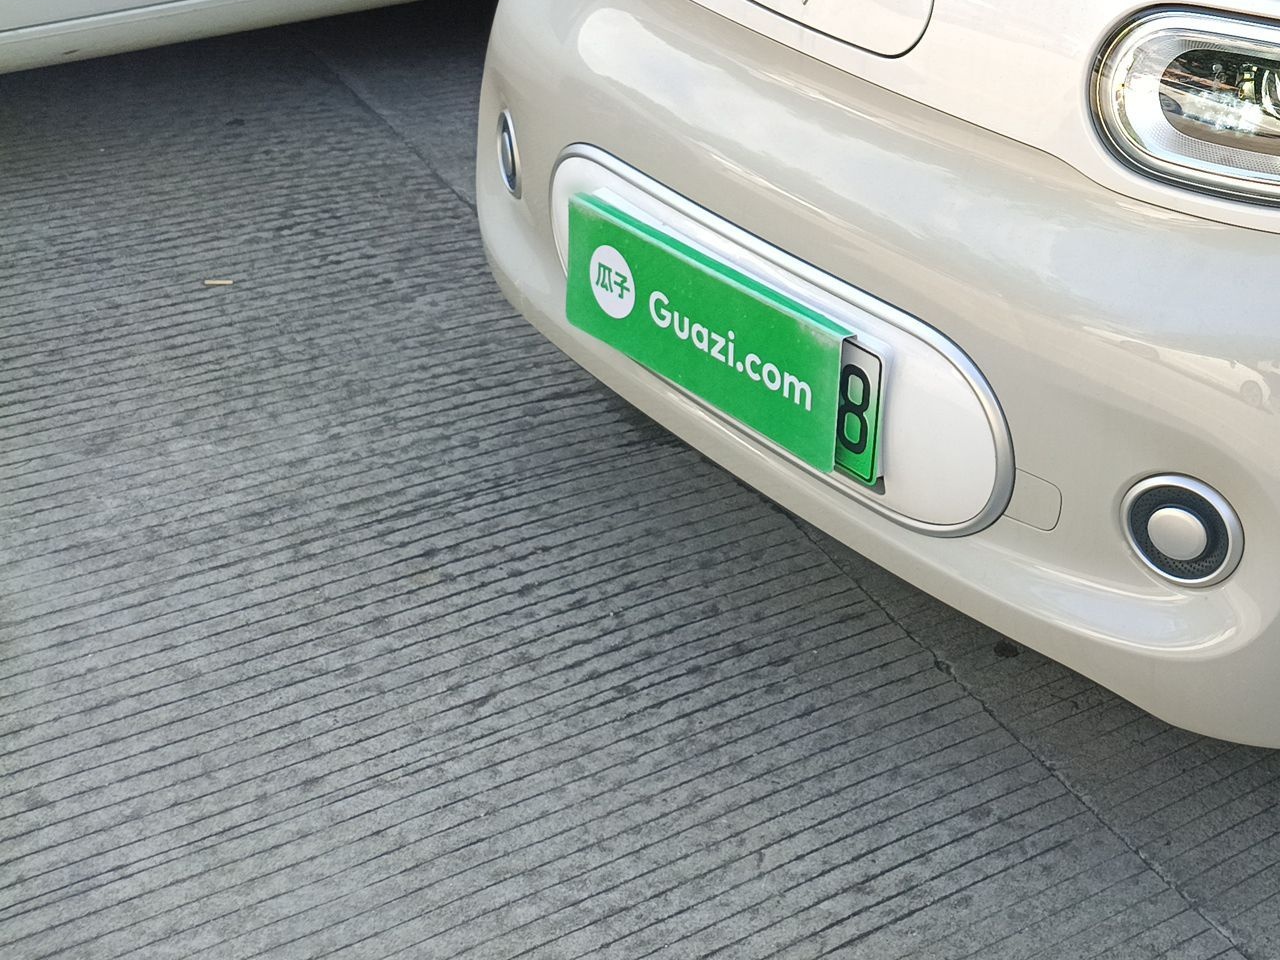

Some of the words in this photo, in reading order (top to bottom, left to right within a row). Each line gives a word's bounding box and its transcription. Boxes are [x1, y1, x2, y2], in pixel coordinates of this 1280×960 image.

[595, 261, 631, 300] 瓜子
[648, 290, 813, 412] Guazi.com
[836, 363, 871, 455] 8
